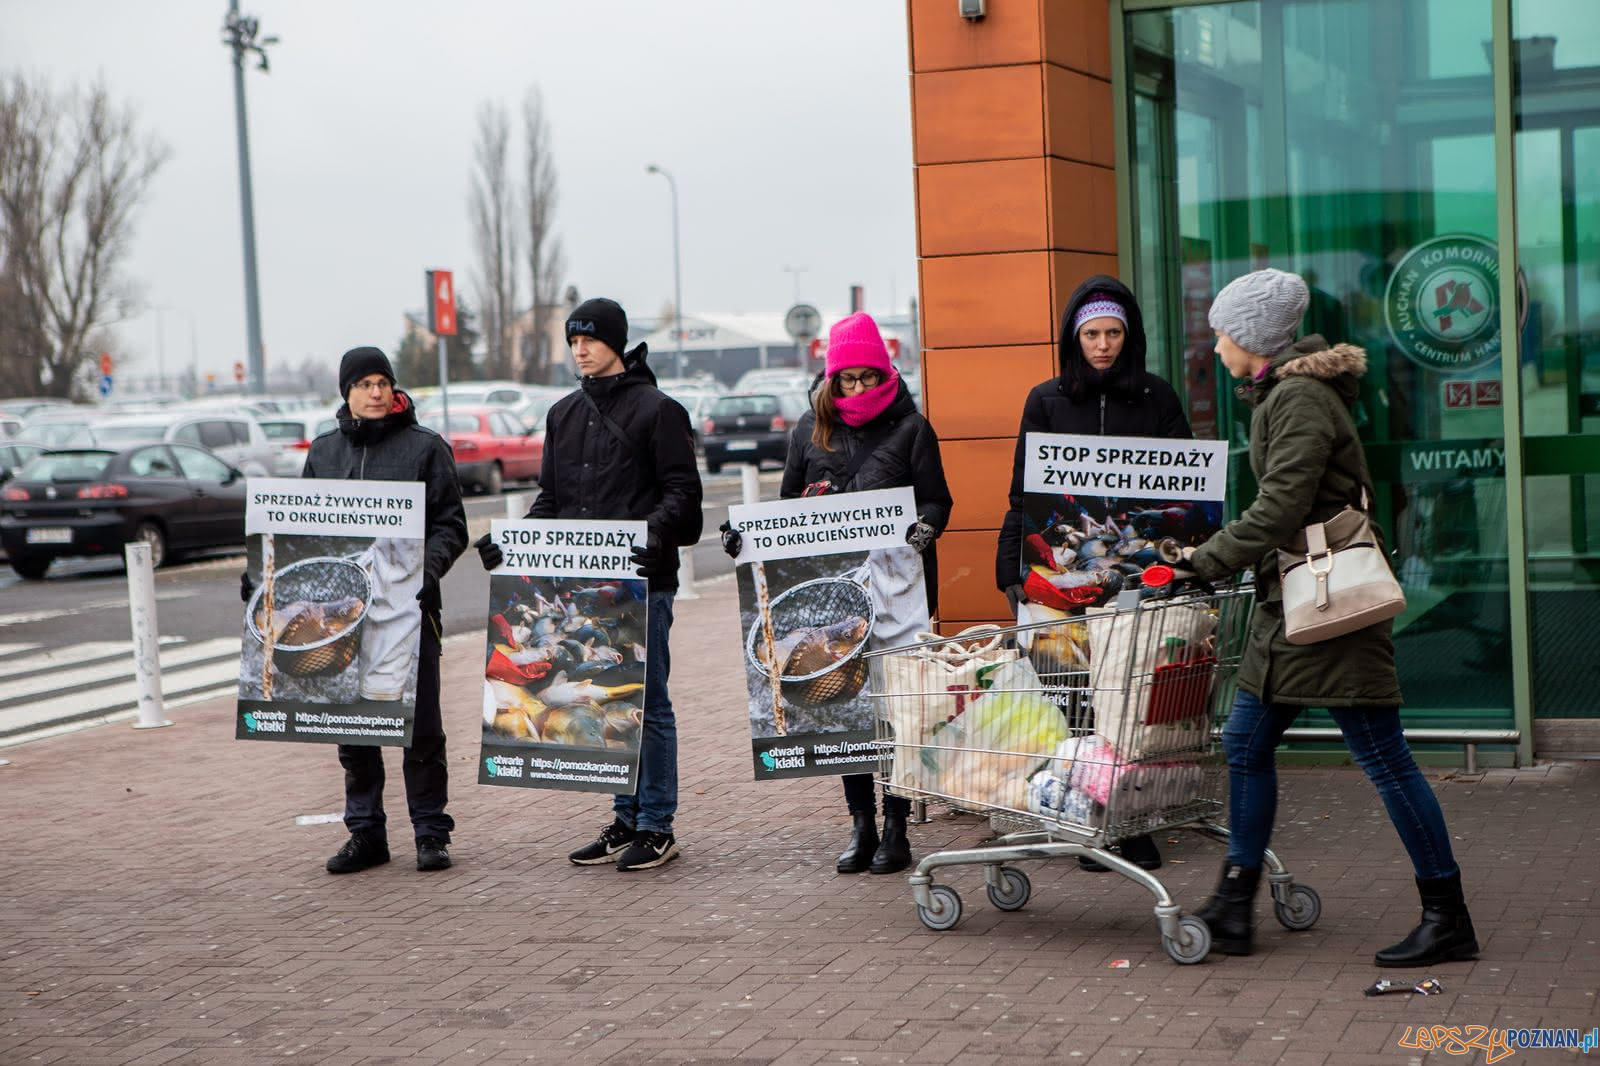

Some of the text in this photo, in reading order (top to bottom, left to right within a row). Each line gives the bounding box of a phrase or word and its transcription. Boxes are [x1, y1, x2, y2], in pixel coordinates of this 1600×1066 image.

[438, 279, 450, 305] 4
[1396, 269, 1419, 332] AUCHAN
[568, 320, 595, 332] FILA
[1414, 341, 1472, 363] CENTRUM
[1038, 444, 1214, 468] STOP SPRZEDAŻY
[1410, 448, 1505, 470] WITAMY
[1043, 465, 1206, 492] ŻYWYCH KARPI!
[254, 493, 413, 509] SPRZEDAŻ ŻYWYCH RYB
[266, 510, 403, 526] TO OKRUCIEŃSTWO!
[738, 505, 904, 533] SPRZEDAŻ ŻYWYCH RYB
[502, 529, 637, 548] STOP SPRZEDAŻY
[753, 523, 896, 549] TO OKRUCIEŃSTWO!
[506, 548, 632, 570] ŻYWYCH KARPI!
[252, 710, 287, 721] otwarte
[256, 720, 286, 732] klatki
[493, 754, 525, 767] otwarte
[768, 745, 805, 758] otwarte
[497, 765, 522, 778] klatki
[775, 755, 805, 769] klatki
